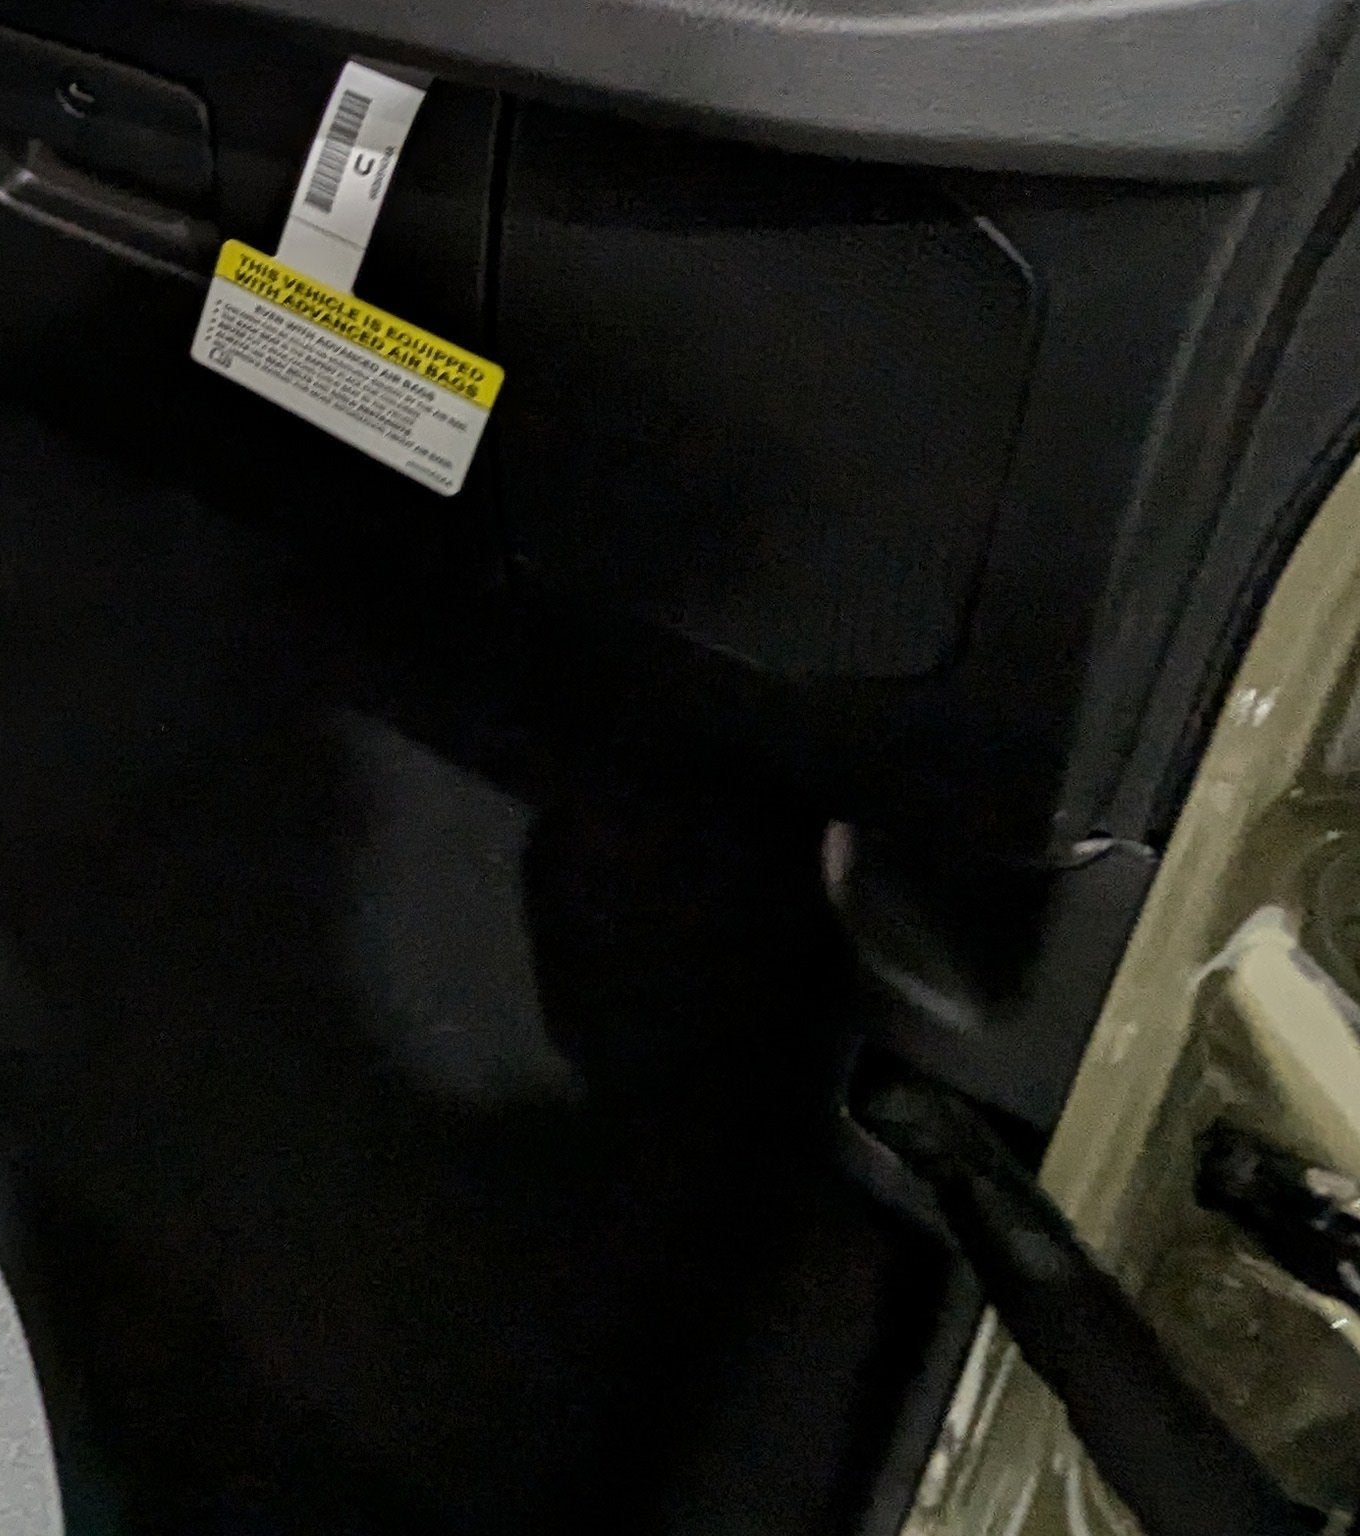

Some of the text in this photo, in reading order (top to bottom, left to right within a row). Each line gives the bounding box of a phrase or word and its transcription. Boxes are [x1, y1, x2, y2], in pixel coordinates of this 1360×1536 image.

[354, 153, 375, 176] U
[233, 268, 480, 398] WITH ADVANCED AIR BAGS
[238, 254, 486, 383] THIS VEHICLE IS EQUIPPED
